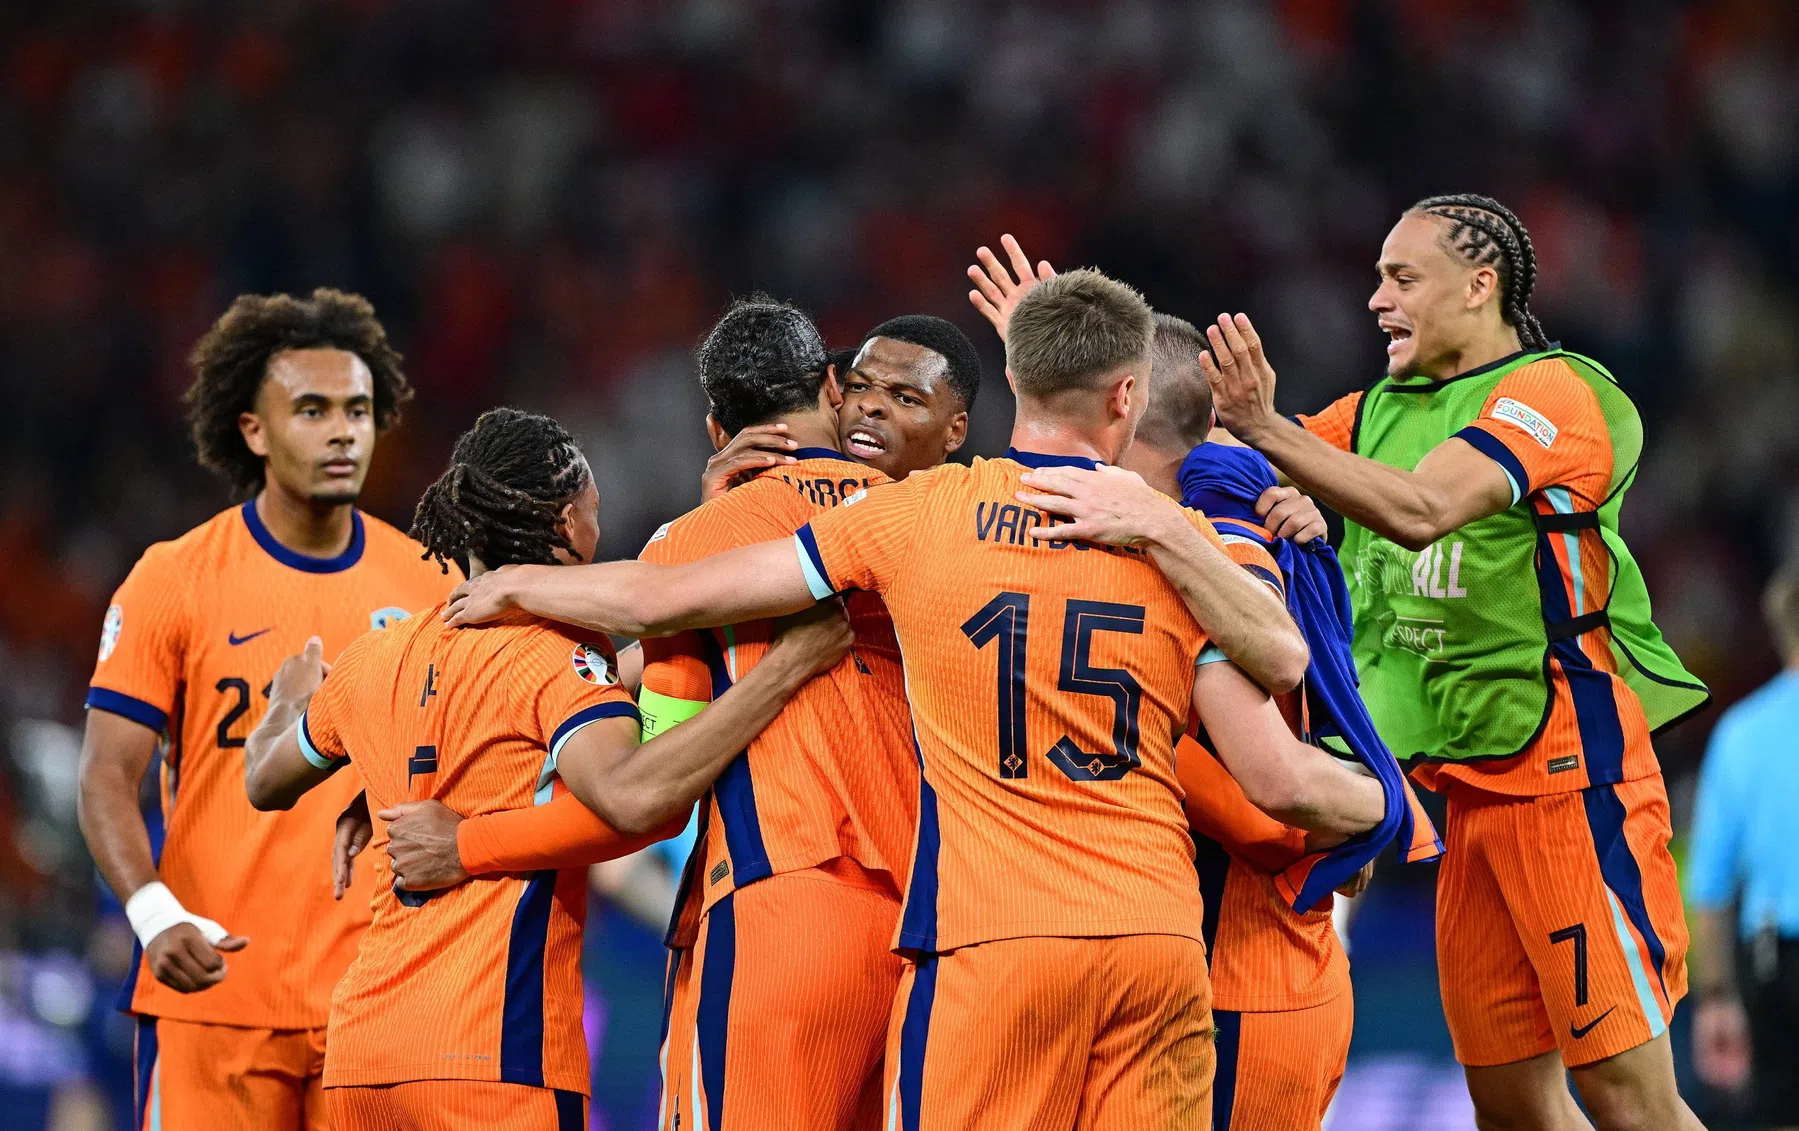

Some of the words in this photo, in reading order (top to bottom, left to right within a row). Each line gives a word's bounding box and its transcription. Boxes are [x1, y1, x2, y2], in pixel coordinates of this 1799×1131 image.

[1497, 403, 1554, 442] FOUNDATION
[976, 501, 1042, 548] VAN
[215, 677, 274, 748] 2
[960, 591, 1146, 782] 15
[1549, 923, 1588, 1008] 7
